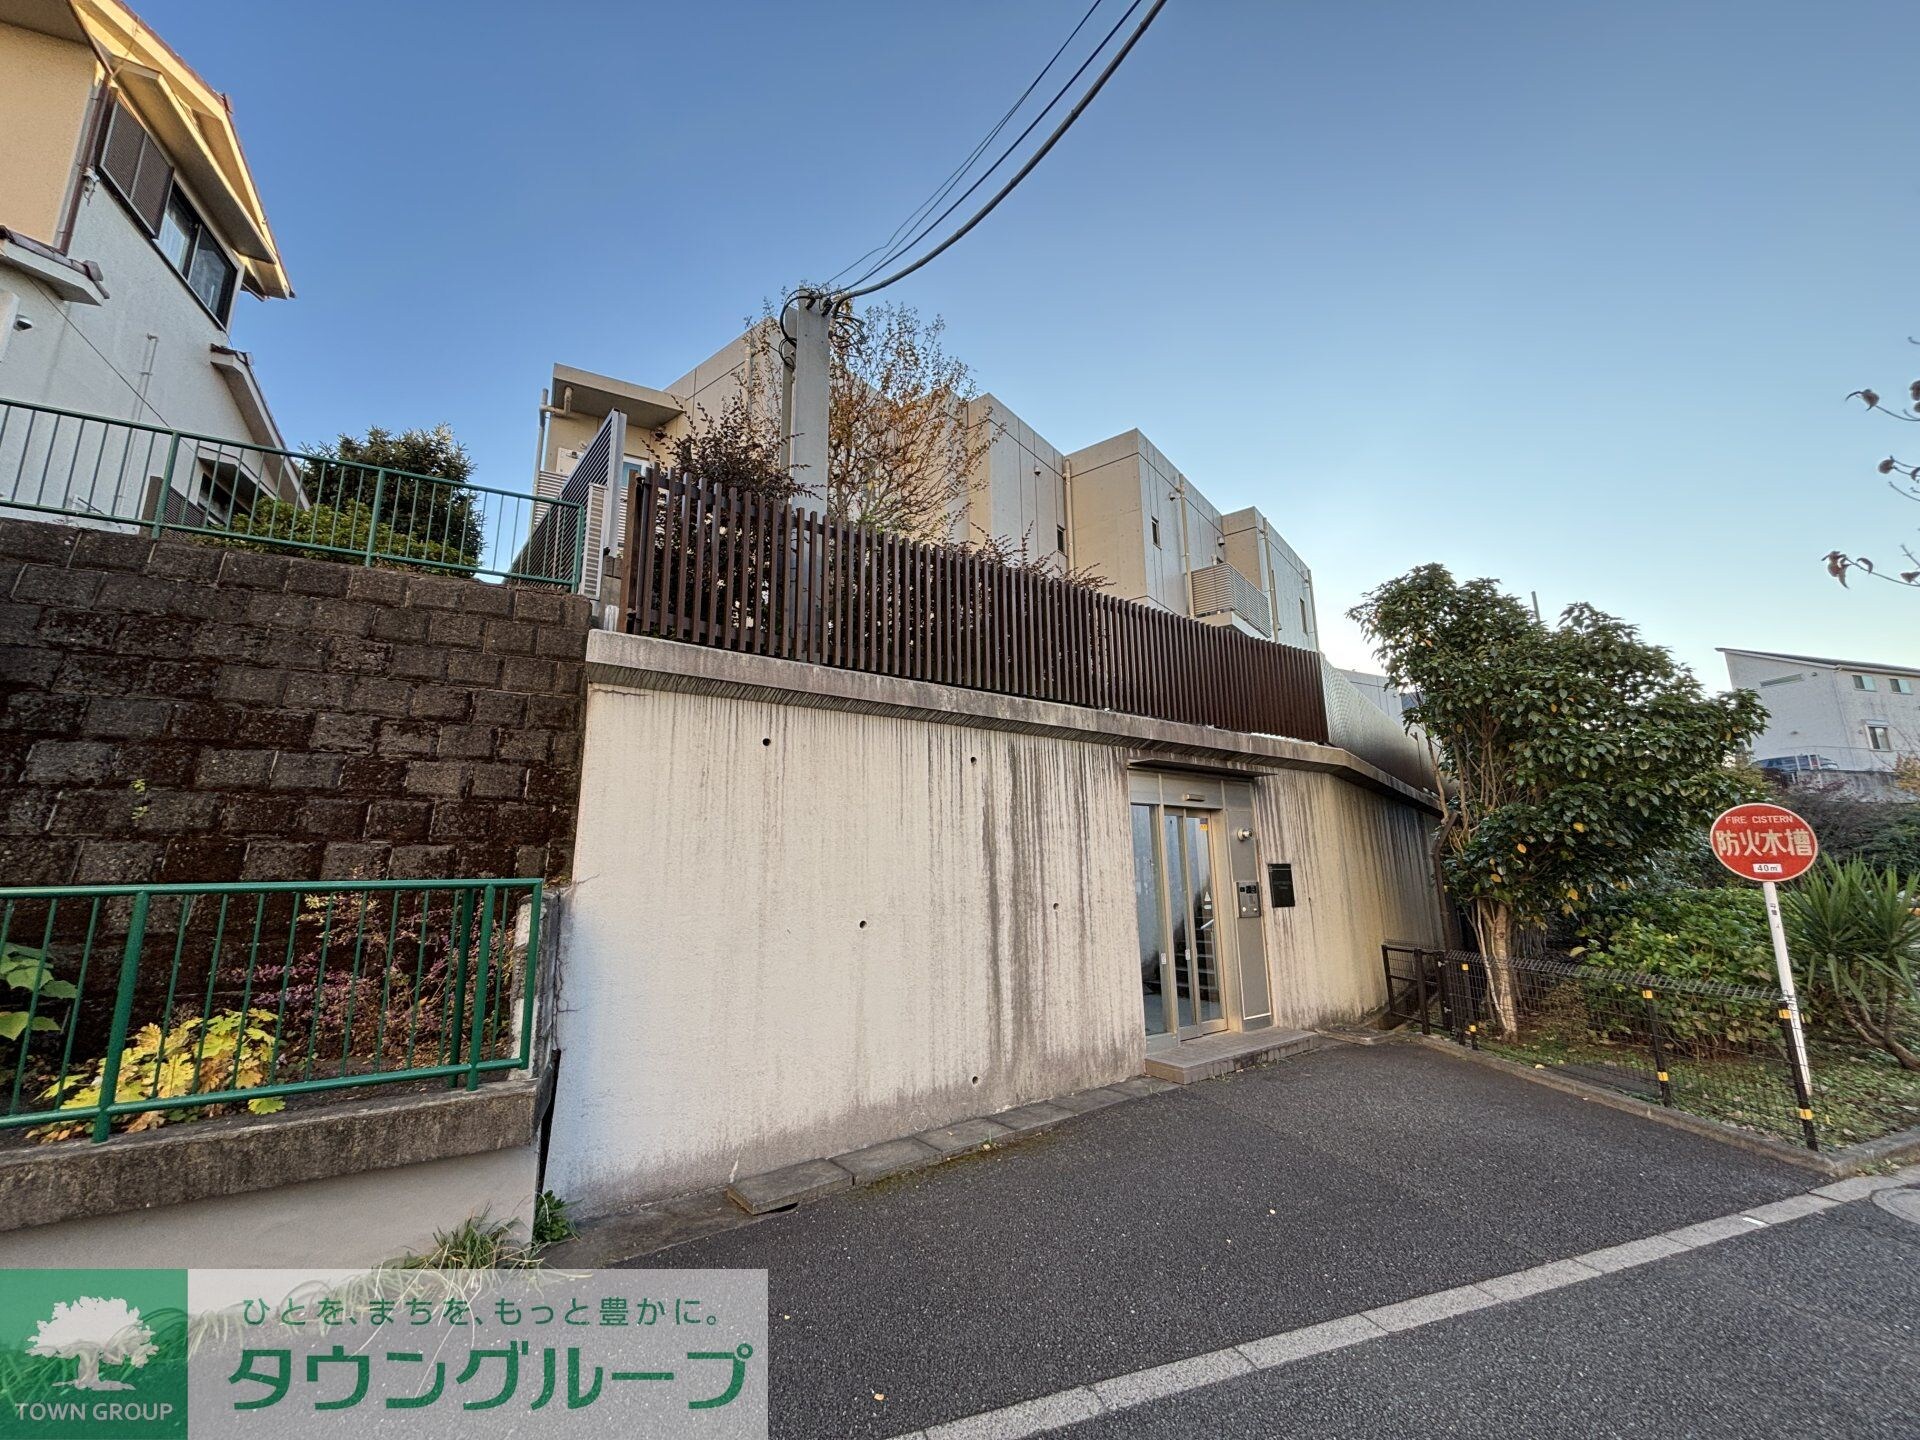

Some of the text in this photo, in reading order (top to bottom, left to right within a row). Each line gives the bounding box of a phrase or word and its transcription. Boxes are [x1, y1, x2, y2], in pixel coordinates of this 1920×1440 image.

[1725, 815, 1794, 824] FIRE CISTERN
[1715, 828, 1813, 857] 防火水槽
